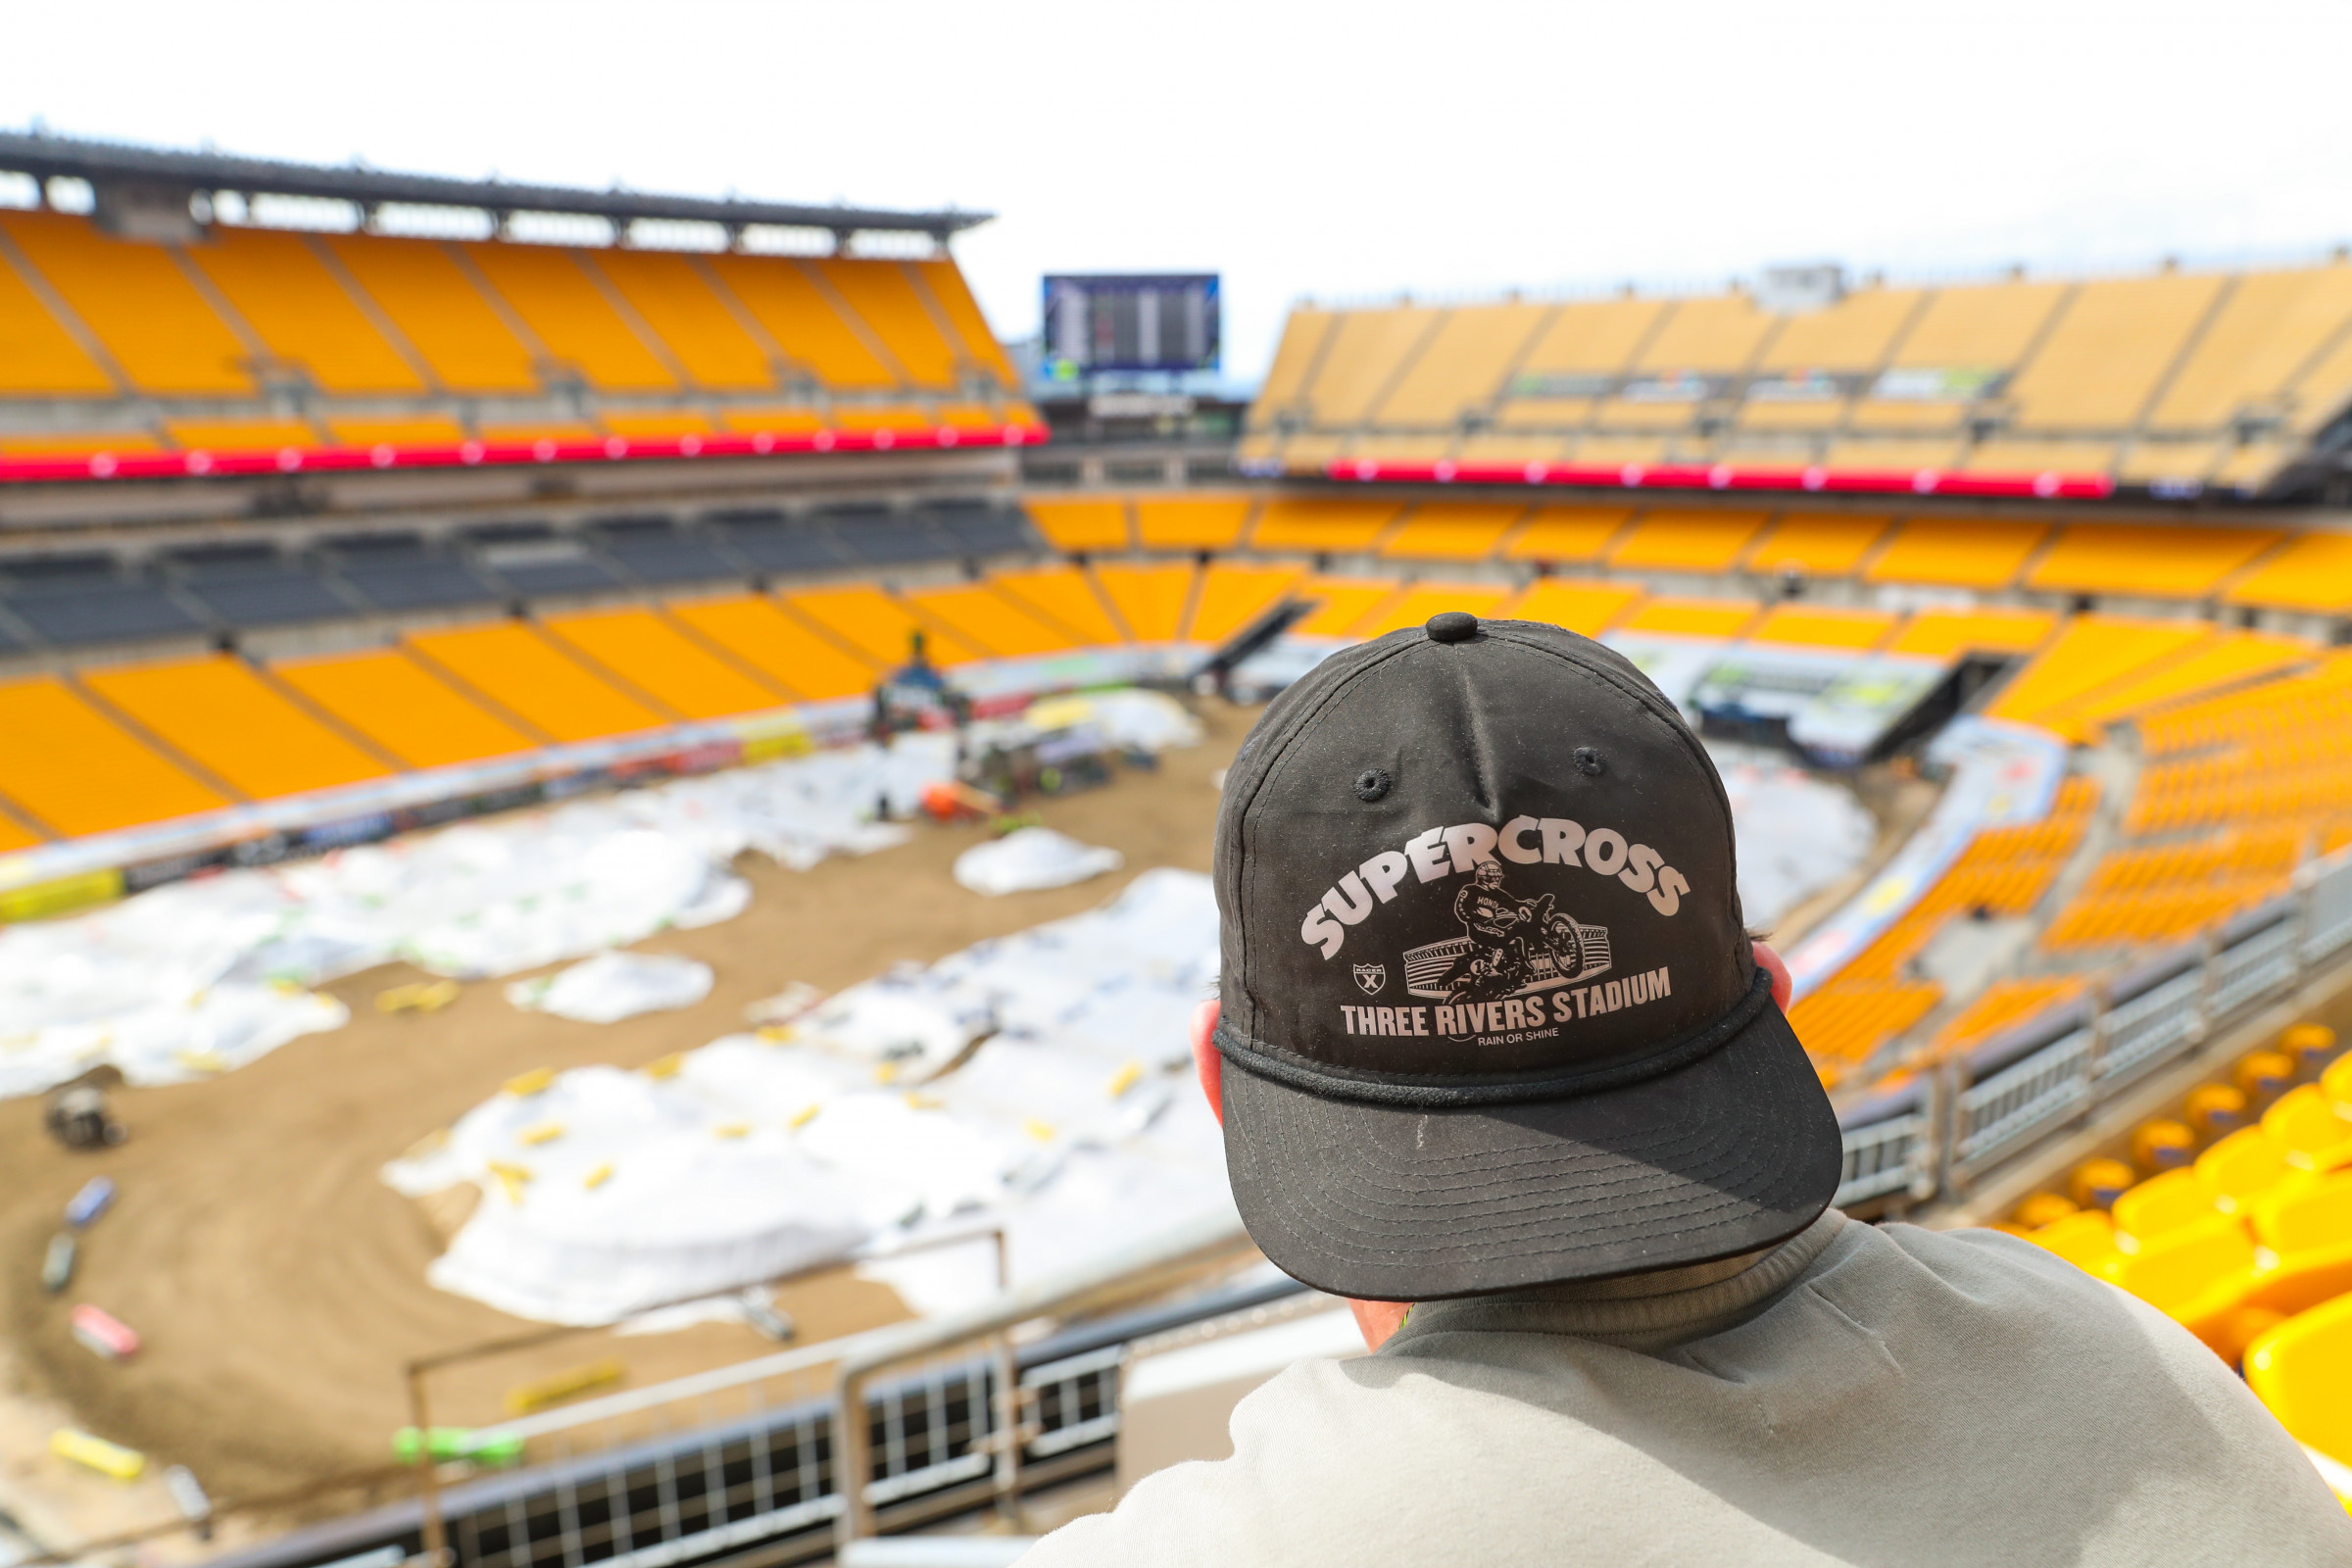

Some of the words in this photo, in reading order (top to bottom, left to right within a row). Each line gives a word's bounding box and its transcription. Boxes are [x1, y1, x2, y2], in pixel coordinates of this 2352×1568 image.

[1301, 814, 1690, 960] SUPERCROSS
[1341, 1005, 1429, 1036] THREE
[1435, 996, 1545, 1036] RIVERS
[1552, 966, 1671, 1022] STADIUM
[1363, 975, 1378, 988] X
[1478, 1036, 1504, 1047] RAIN
[1506, 1033, 1523, 1044] OR
[1526, 1027, 1559, 1041] SHINE
